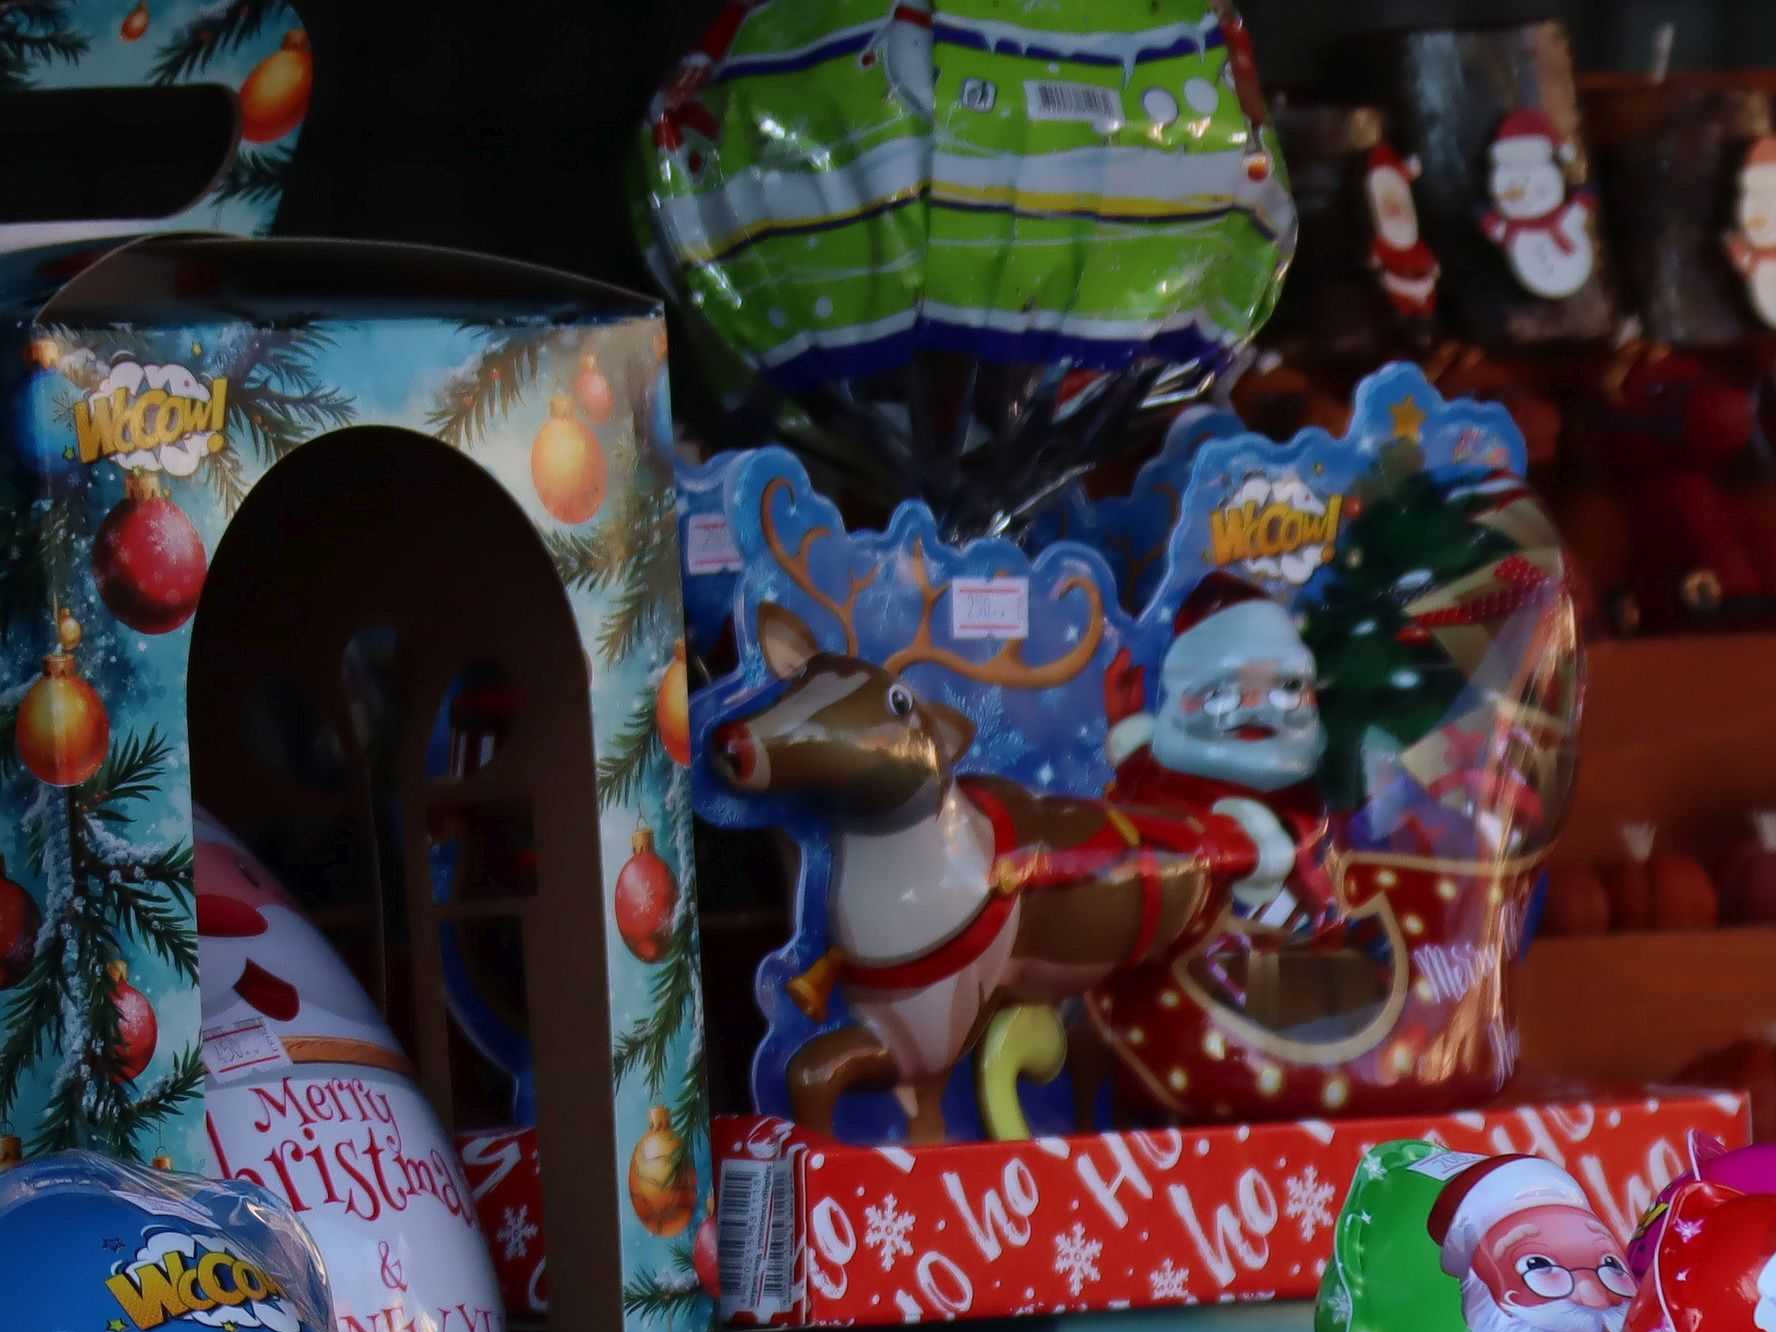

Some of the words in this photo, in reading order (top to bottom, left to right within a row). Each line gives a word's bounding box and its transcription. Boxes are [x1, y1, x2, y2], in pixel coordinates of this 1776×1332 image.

[248, 1077, 402, 1147] Merry
[205, 1108, 478, 1228] hristma
[378, 1239, 408, 1292] &
